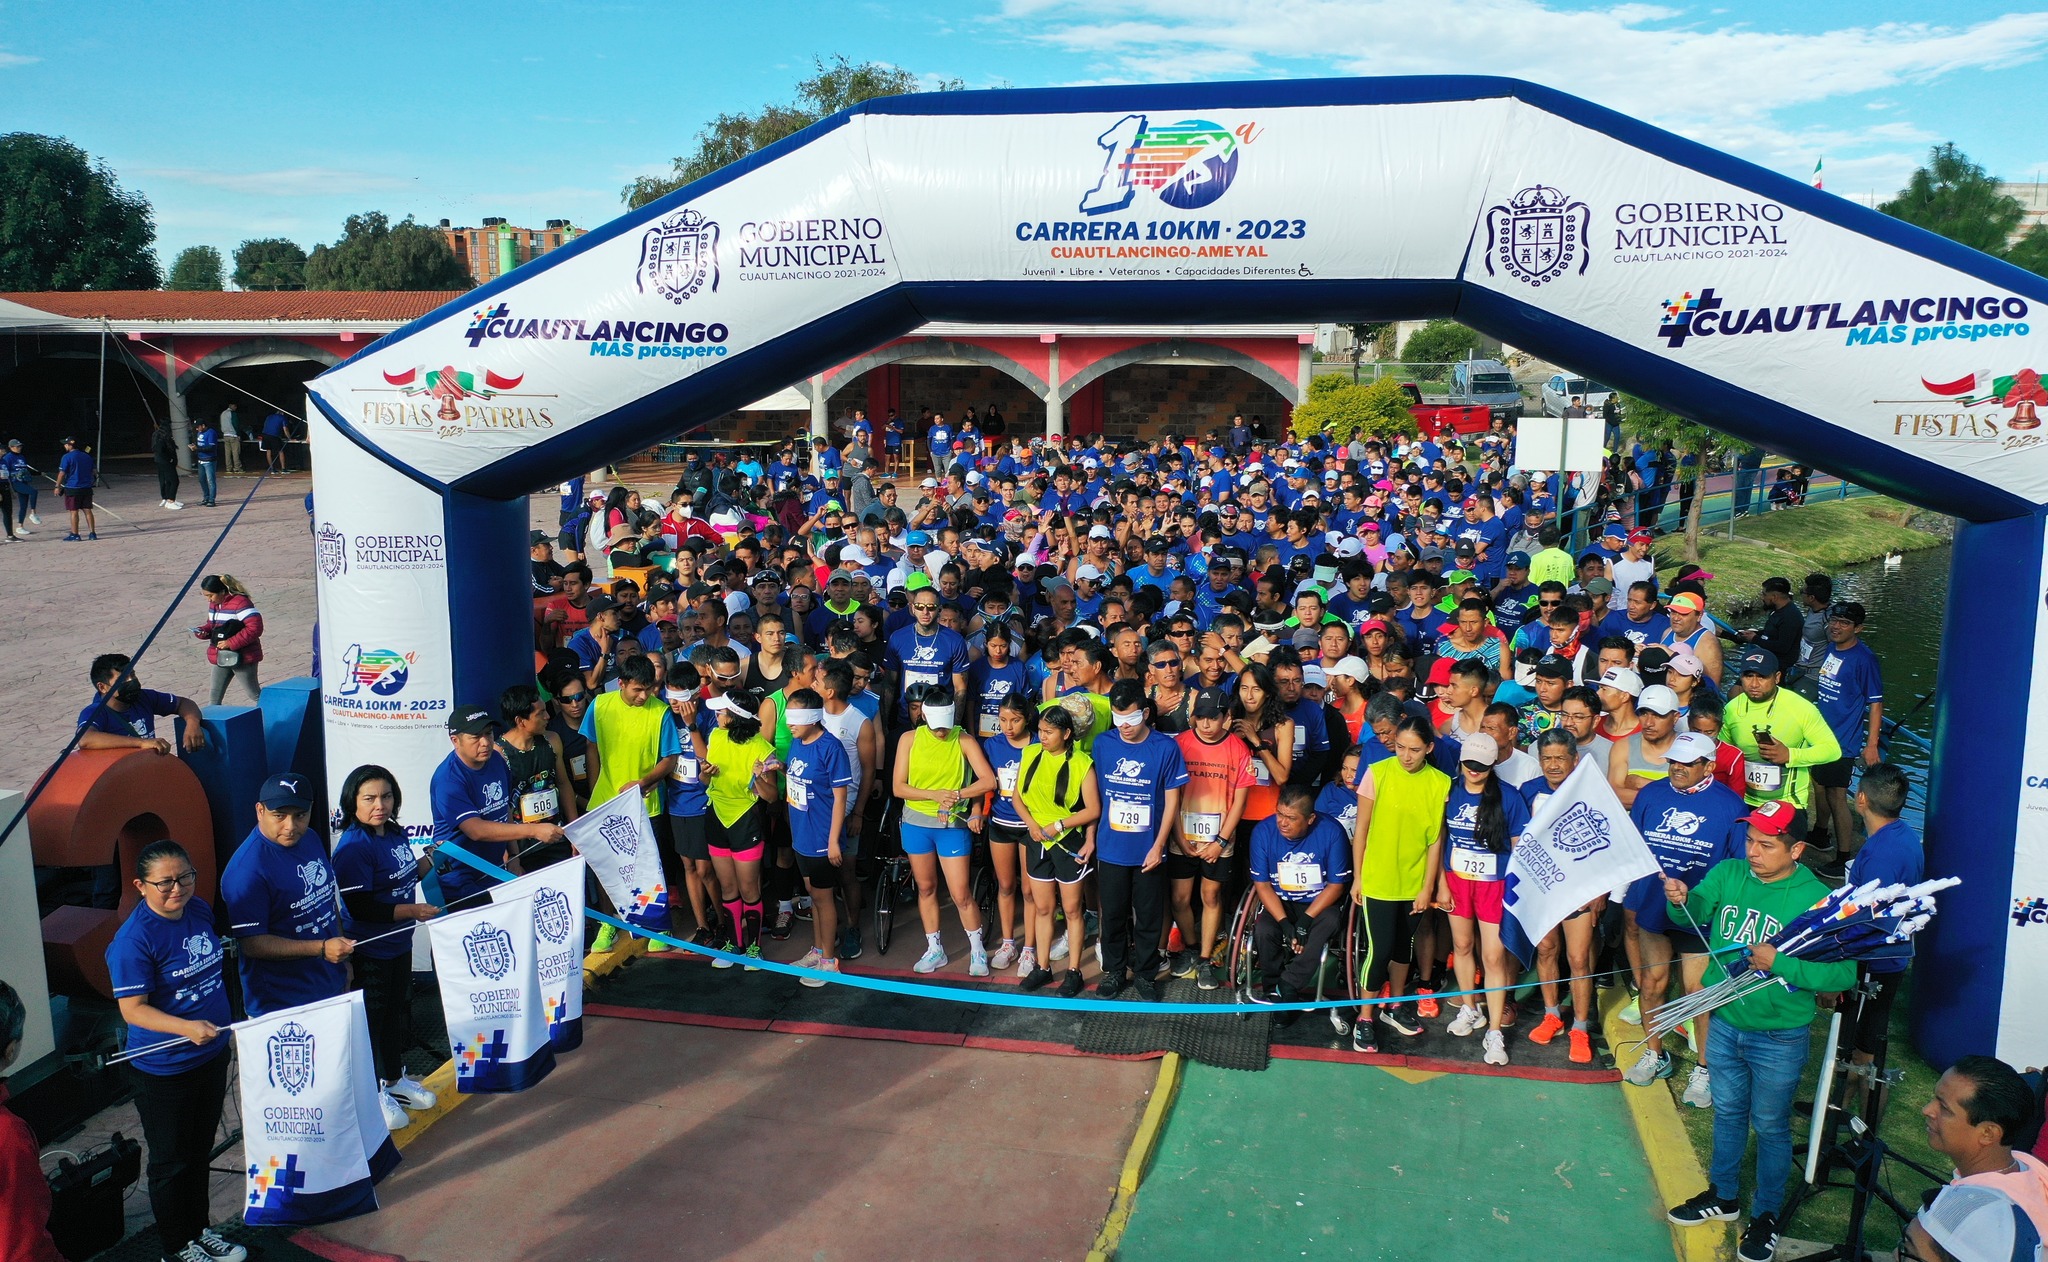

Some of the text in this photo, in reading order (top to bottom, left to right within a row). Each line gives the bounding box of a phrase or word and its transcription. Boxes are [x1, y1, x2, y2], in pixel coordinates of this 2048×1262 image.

[1615, 202, 1784, 225] GOBIERNO
[738, 217, 882, 243] GOBIERNO
[1015, 219, 1306, 242] CARRERA 10KM 2023
[1615, 225, 1787, 250] MUNICIPAL
[739, 243, 886, 268] MUNICIPAL
[1050, 246, 1268, 260] CUAUTLANCINGO-AMEYAL
[1613, 248, 1789, 264] CUAUTLANCINGO 2021-2024
[739, 268, 886, 282] CUAUTLANCINGO 2021-2024
[1022, 265, 1296, 277] Juvenil Libre Veteranos Capacidades Diferentes
[1691, 296, 2029, 338] CUAUTLANCINGO
[486, 318, 729, 344] CUAUTLANCINGO
[1845, 321, 2030, 347] MÁS próspero
[590, 338, 728, 359] MÁS próspero
[363, 401, 555, 429] FIESTAS PATRIAS
[1893, 413, 1999, 439] FIESTAS
[354, 534, 443, 549] GOBIERNO
[356, 549, 444, 563] MUNICIPAL
[324, 694, 447, 711] CARRERA 10KM 2023
[332, 708, 428, 720] CUAUTLANCINGO-AMEYAL
[1748, 771, 1768, 784] 487
[533, 798, 552, 814] 505
[1119, 811, 1140, 825] 739
[1193, 822, 1211, 835] 106
[1671, 835, 1692, 843] 10KM
[1693, 839, 1714, 848] 2023
[1522, 832, 1566, 883] GOBIERNO
[1463, 859, 1485, 874] 732
[1295, 872, 1307, 884] 15
[1720, 904, 1784, 946] GAP
[469, 987, 520, 1003] GOBIERNO
[472, 1000, 522, 1015] MUNICIPAL
[263, 1106, 323, 1121] GOBIERNO
[265, 1121, 325, 1135] MUNICIPAL
